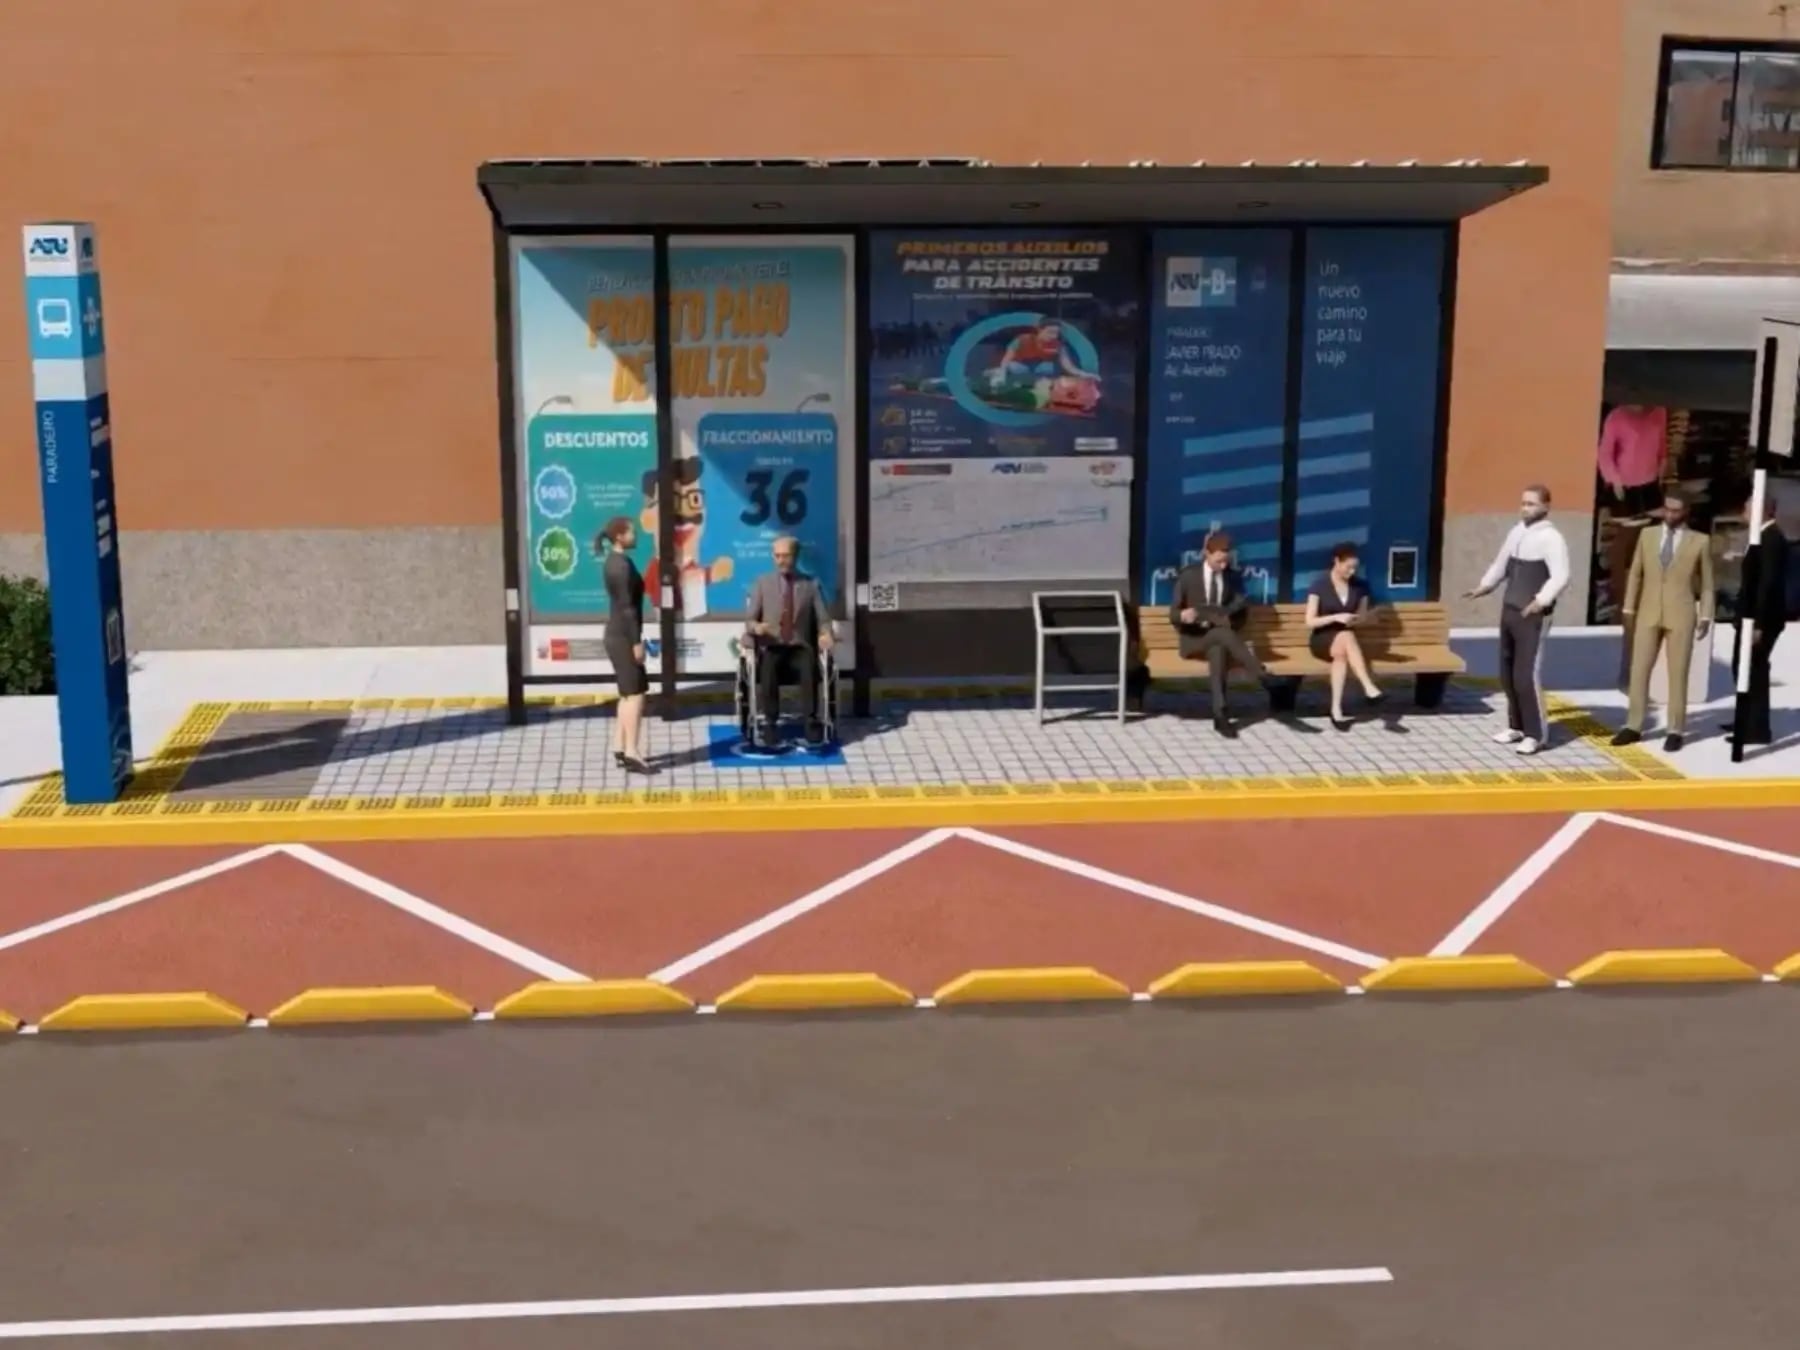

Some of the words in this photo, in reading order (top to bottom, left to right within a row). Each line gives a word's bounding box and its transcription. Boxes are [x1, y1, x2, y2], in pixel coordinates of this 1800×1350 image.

[30, 237, 68, 255] ATU
[898, 241, 1006, 255] PRIMEROS
[1009, 240, 1108, 254] AUXILIOS
[903, 258, 960, 272] PARA
[967, 257, 1099, 271] ACCIDENTES
[1320, 260, 1339, 276] Un
[934, 276, 960, 289] DE
[1318, 286, 1360, 299] nuevo
[714, 284, 790, 337] PAGO
[1317, 305, 1367, 320] camino
[1317, 328, 1345, 346] para
[1348, 327, 1362, 342] tu
[1202, 344, 1242, 360] PRADO
[1316, 350, 1347, 368] viaje
[544, 431, 649, 448] DESCUENTOS
[703, 428, 834, 446] FRACCIONAMIENTO
[740, 468, 811, 527] 36
